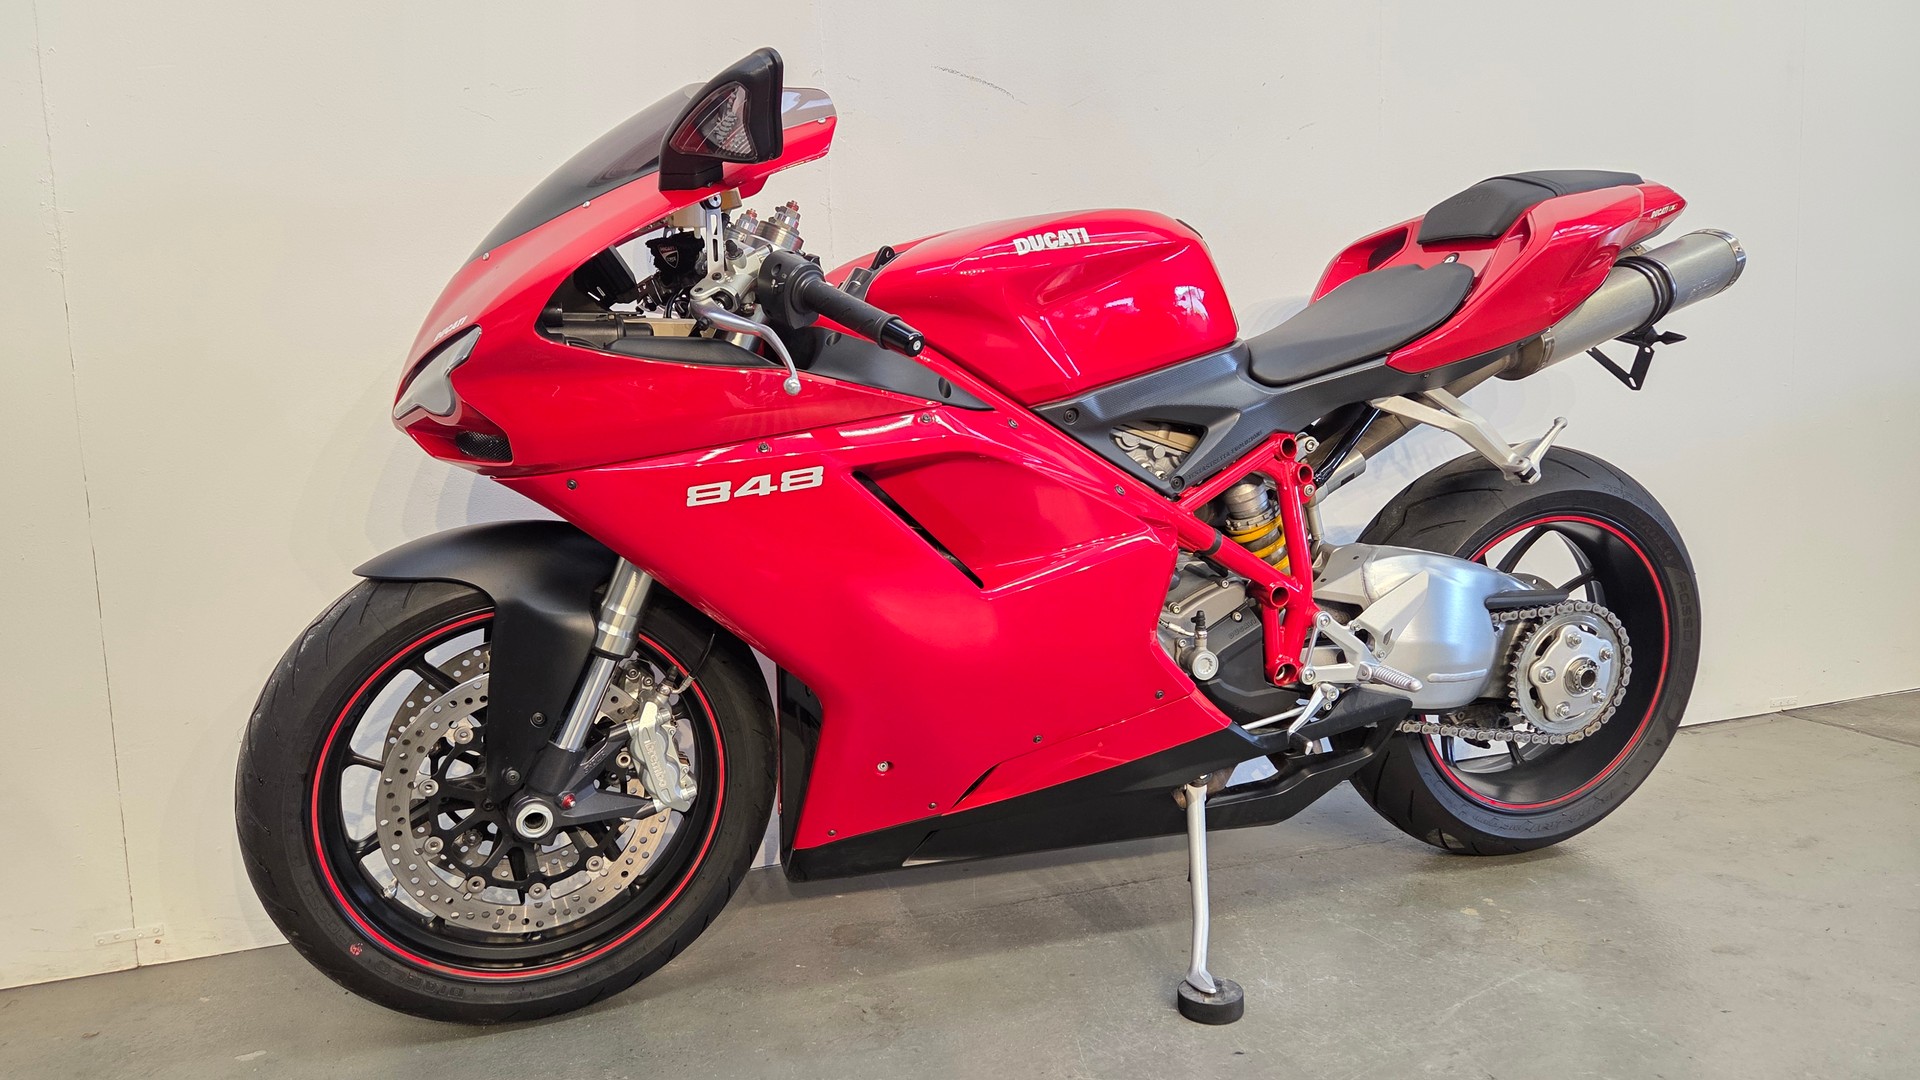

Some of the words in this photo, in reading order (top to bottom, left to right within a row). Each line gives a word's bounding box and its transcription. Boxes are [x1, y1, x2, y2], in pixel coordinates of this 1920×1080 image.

[1013, 227, 1091, 256] DUCATI
[432, 314, 468, 343] DUCATI
[686, 465, 825, 508] 848
[1676, 581, 1694, 641] ROSSO
[643, 739, 667, 788] brembo
